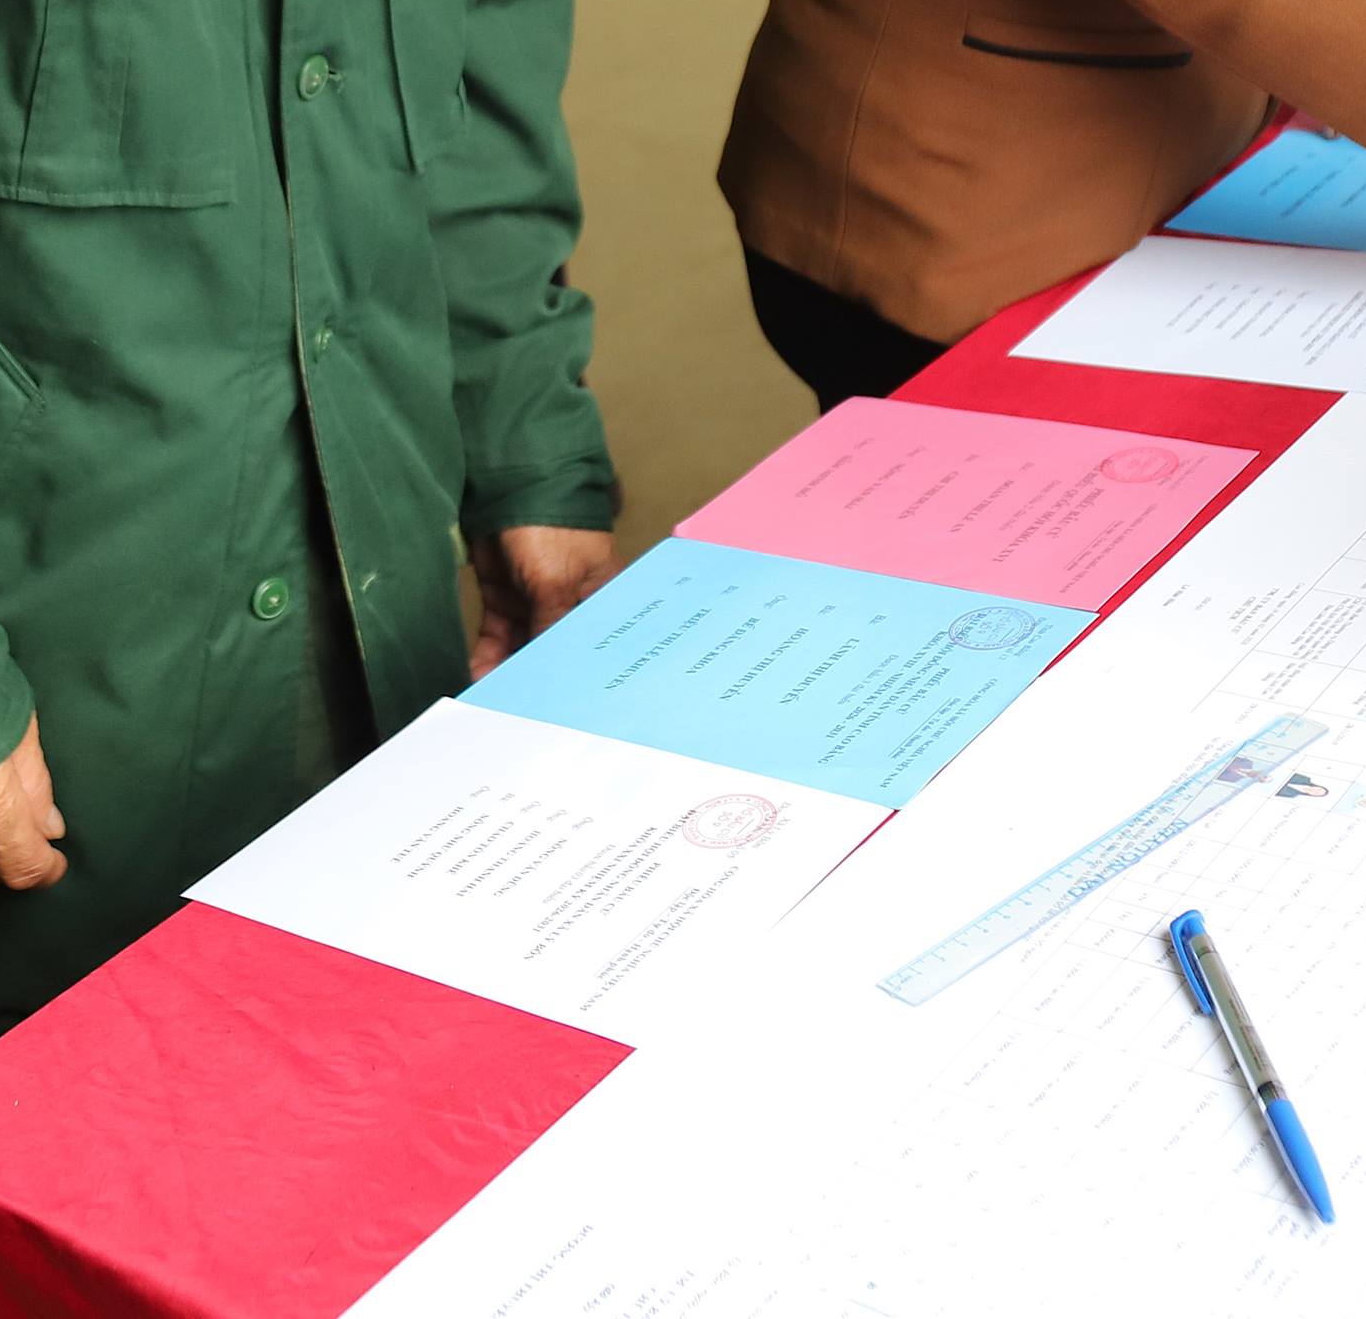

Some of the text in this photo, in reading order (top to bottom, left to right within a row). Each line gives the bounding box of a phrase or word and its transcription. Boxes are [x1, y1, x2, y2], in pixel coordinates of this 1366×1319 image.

[591, 635, 619, 650] LAN
[683, 651, 721, 674] KHOA
[839, 729, 863, 745] CAO
[613, 848, 633, 862] XXI
[473, 857, 509, 882] THANH
[577, 992, 604, 1011] NAM
